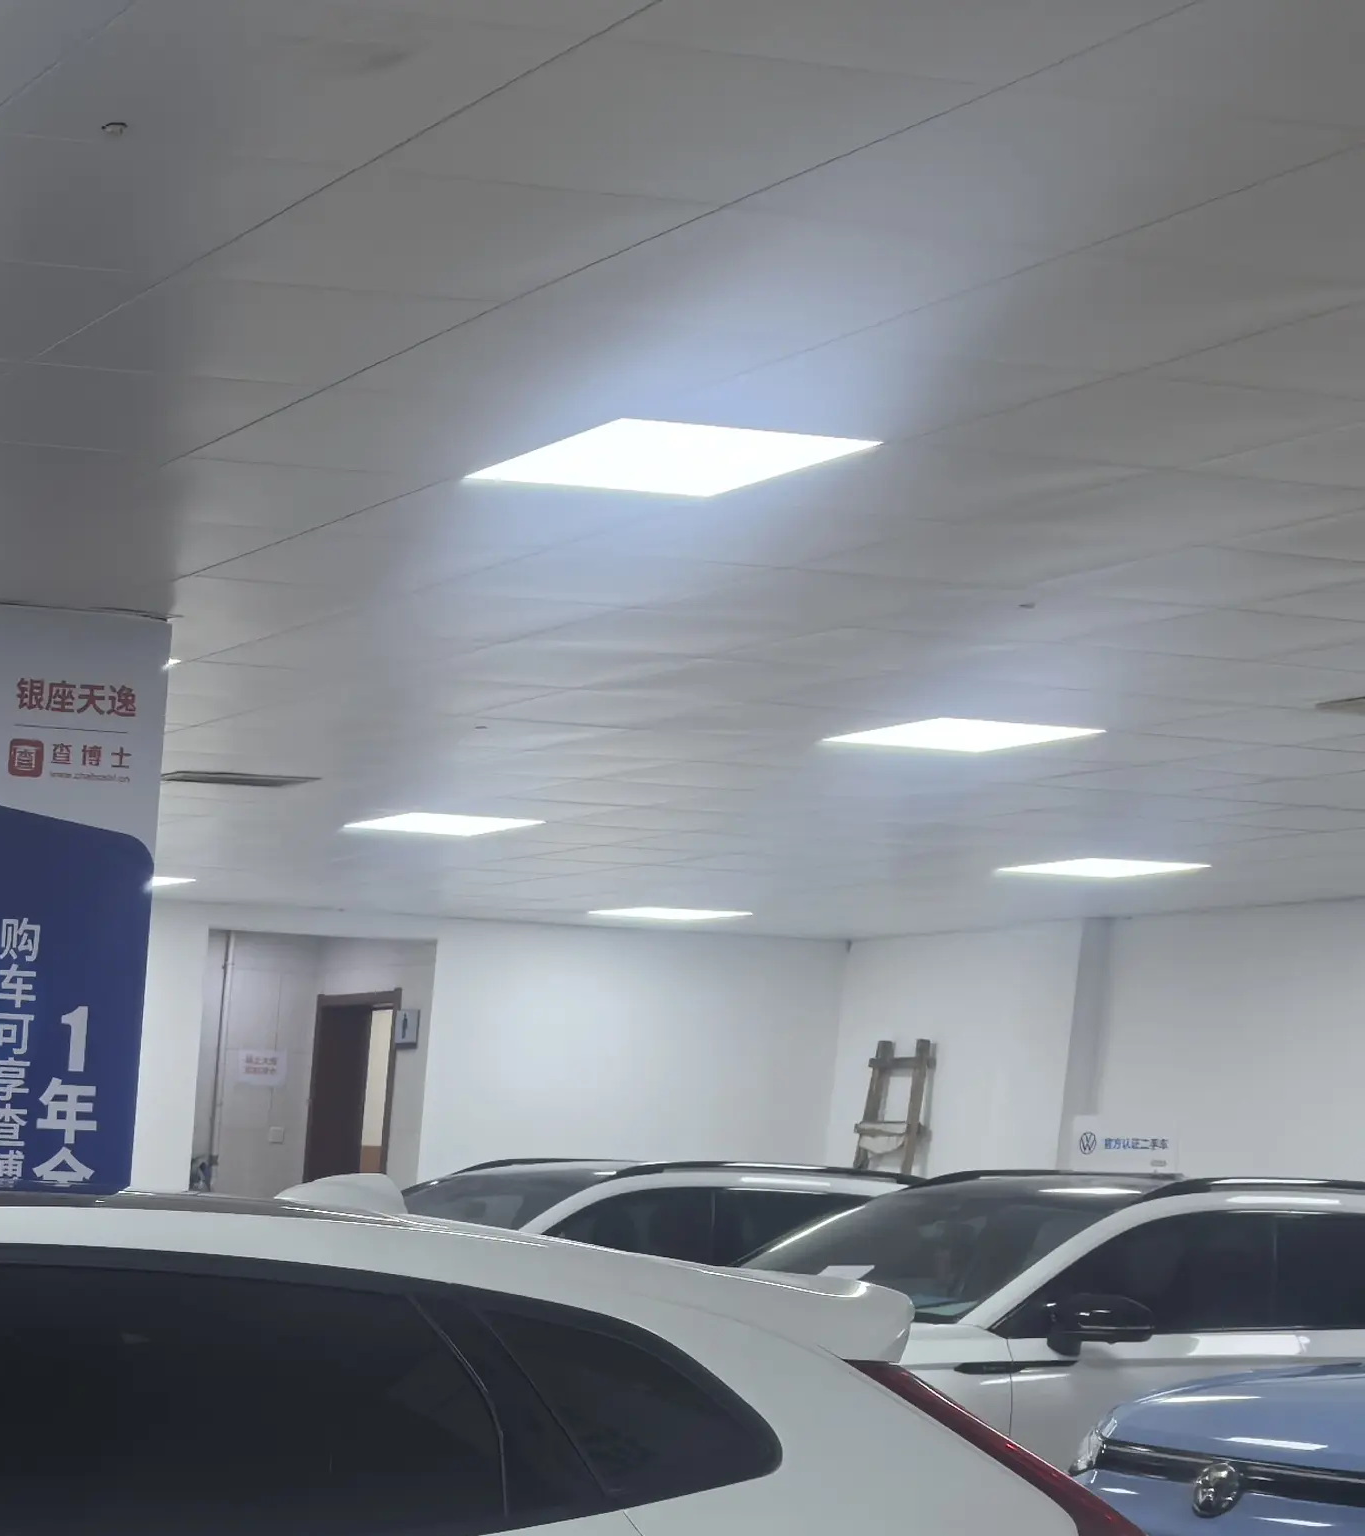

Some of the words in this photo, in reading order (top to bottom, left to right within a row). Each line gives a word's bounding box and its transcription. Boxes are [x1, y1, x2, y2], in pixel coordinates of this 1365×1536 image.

[16, 677, 136, 717] 银座天逸
[51, 742, 132, 769] 查博士
